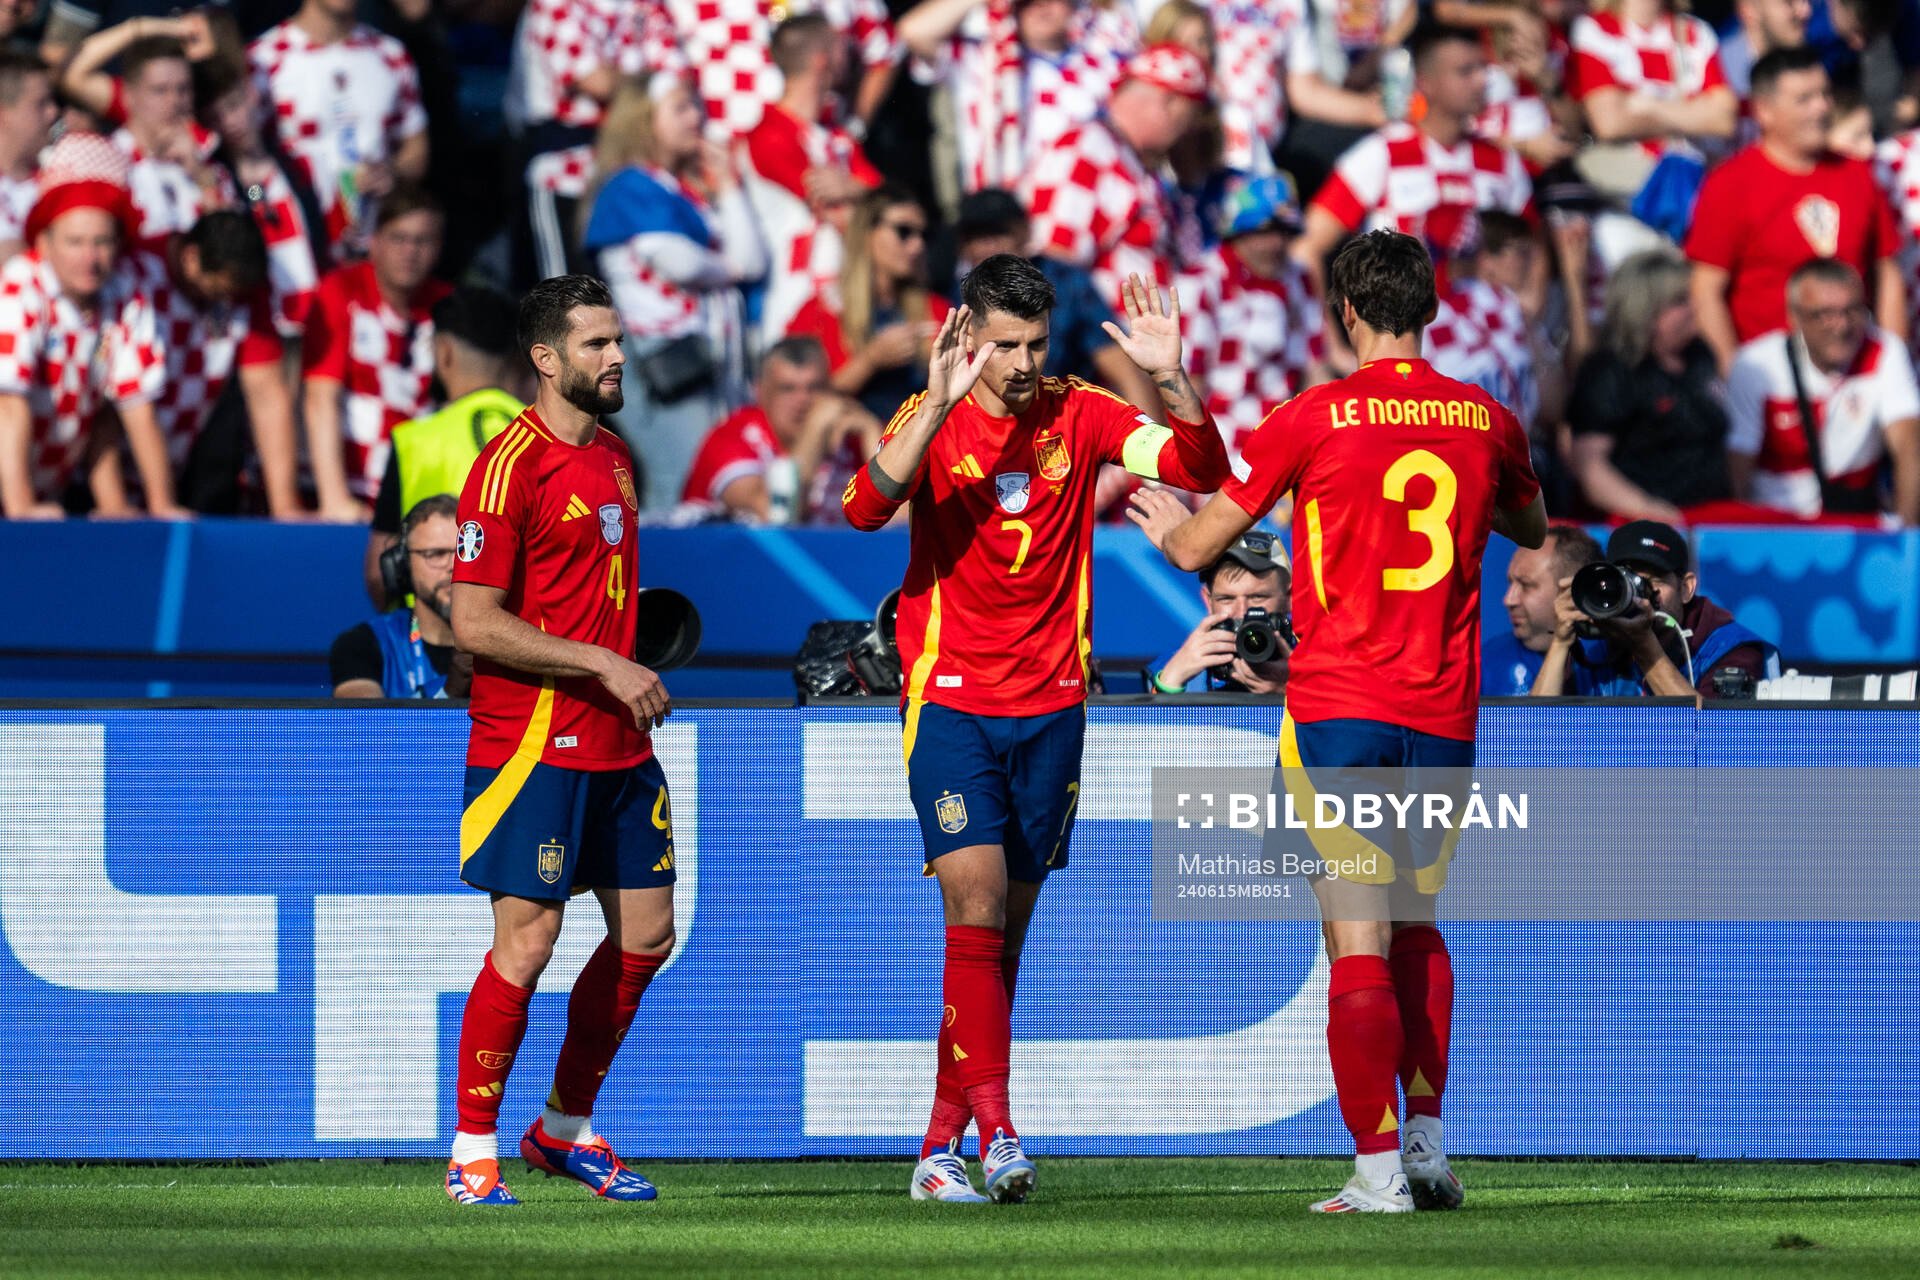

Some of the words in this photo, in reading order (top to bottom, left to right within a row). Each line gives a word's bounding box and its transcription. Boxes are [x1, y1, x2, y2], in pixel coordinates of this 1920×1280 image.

[1330, 398, 1362, 429] LE
[1368, 398, 1490, 430] NORMAND
[1001, 519, 1033, 574] 7
[1383, 449, 1457, 591] 3
[607, 554, 626, 610] 4
